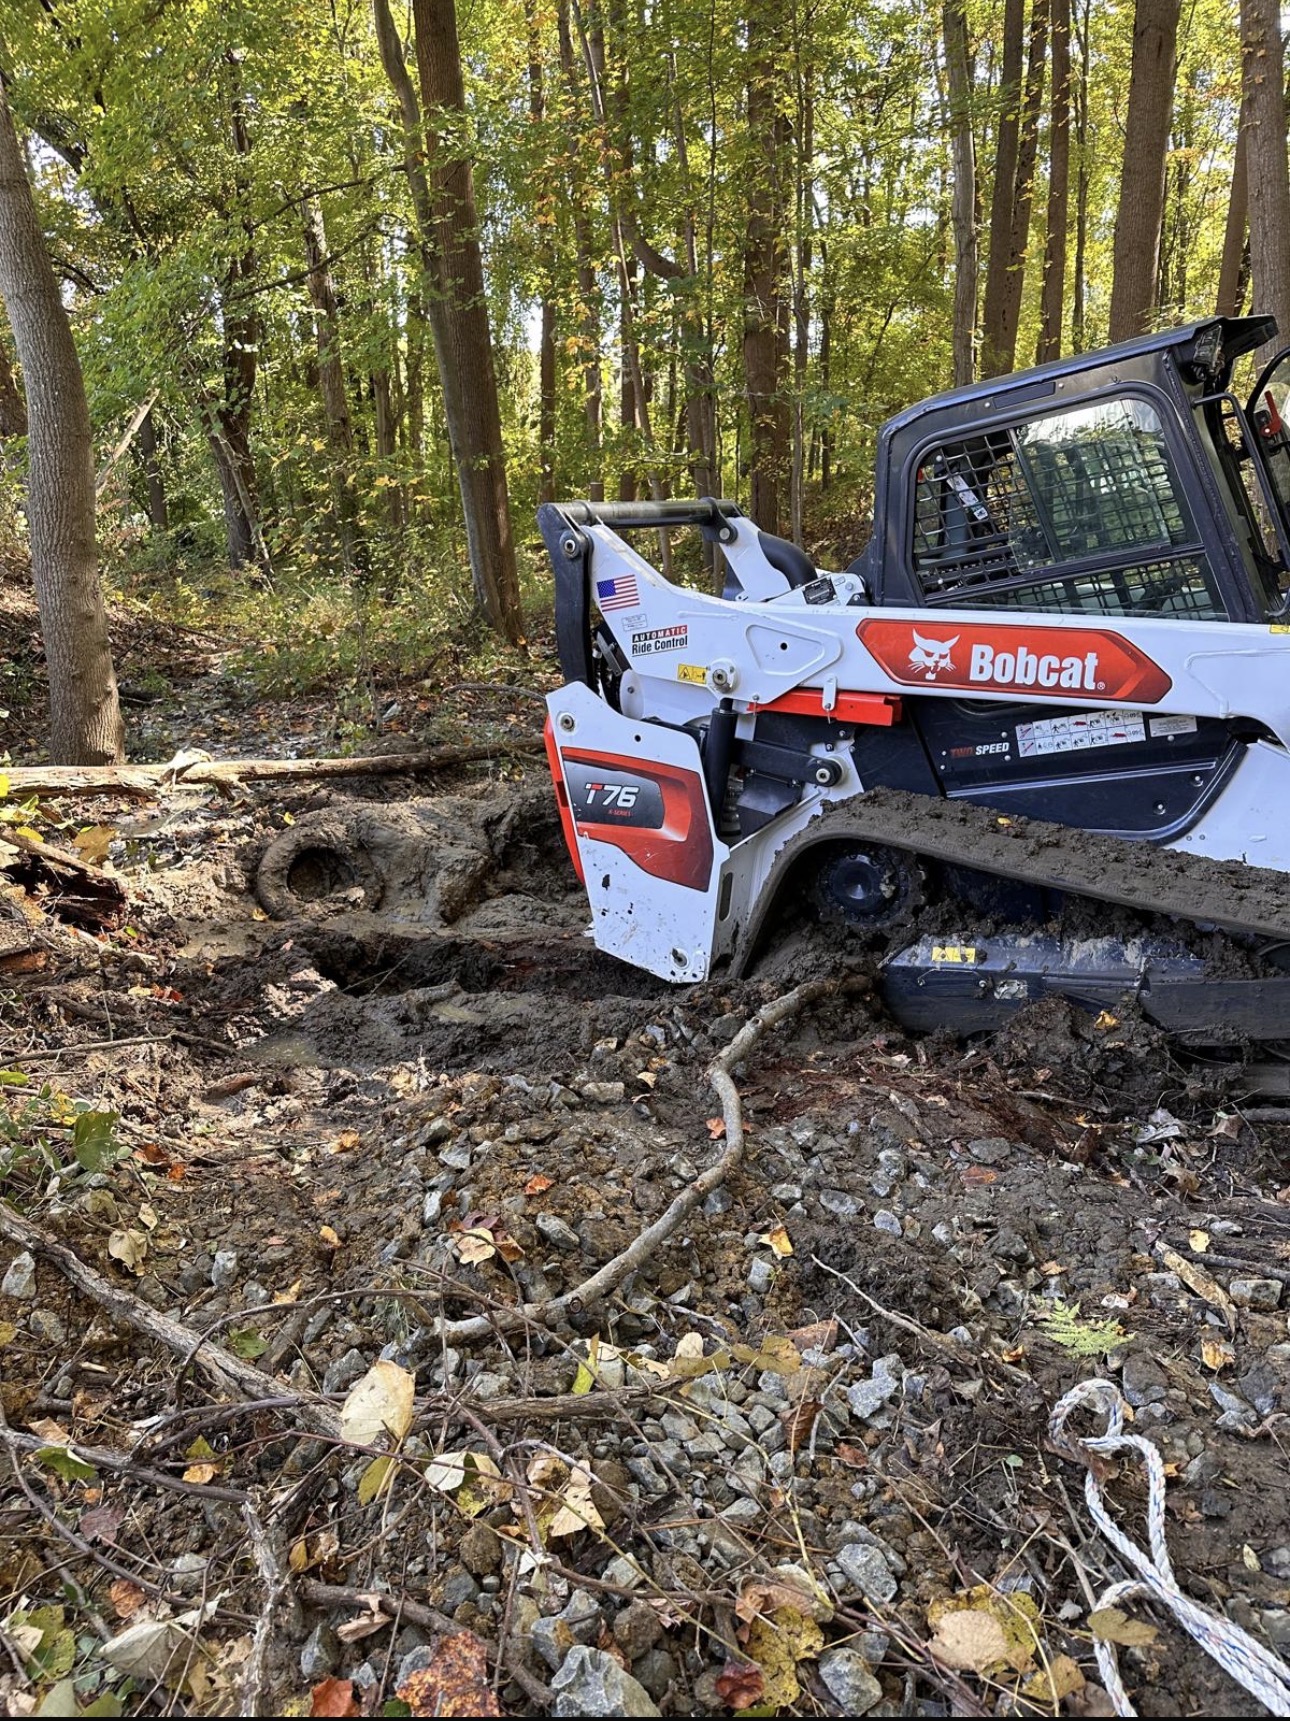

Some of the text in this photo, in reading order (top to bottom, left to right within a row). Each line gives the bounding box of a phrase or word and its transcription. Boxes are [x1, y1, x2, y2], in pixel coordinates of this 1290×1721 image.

[633, 626, 686, 641] AUTOMATIC
[632, 635, 688, 655] Ride Control
[975, 742, 1010, 756] SPEED
[585, 783, 640, 808] T76
